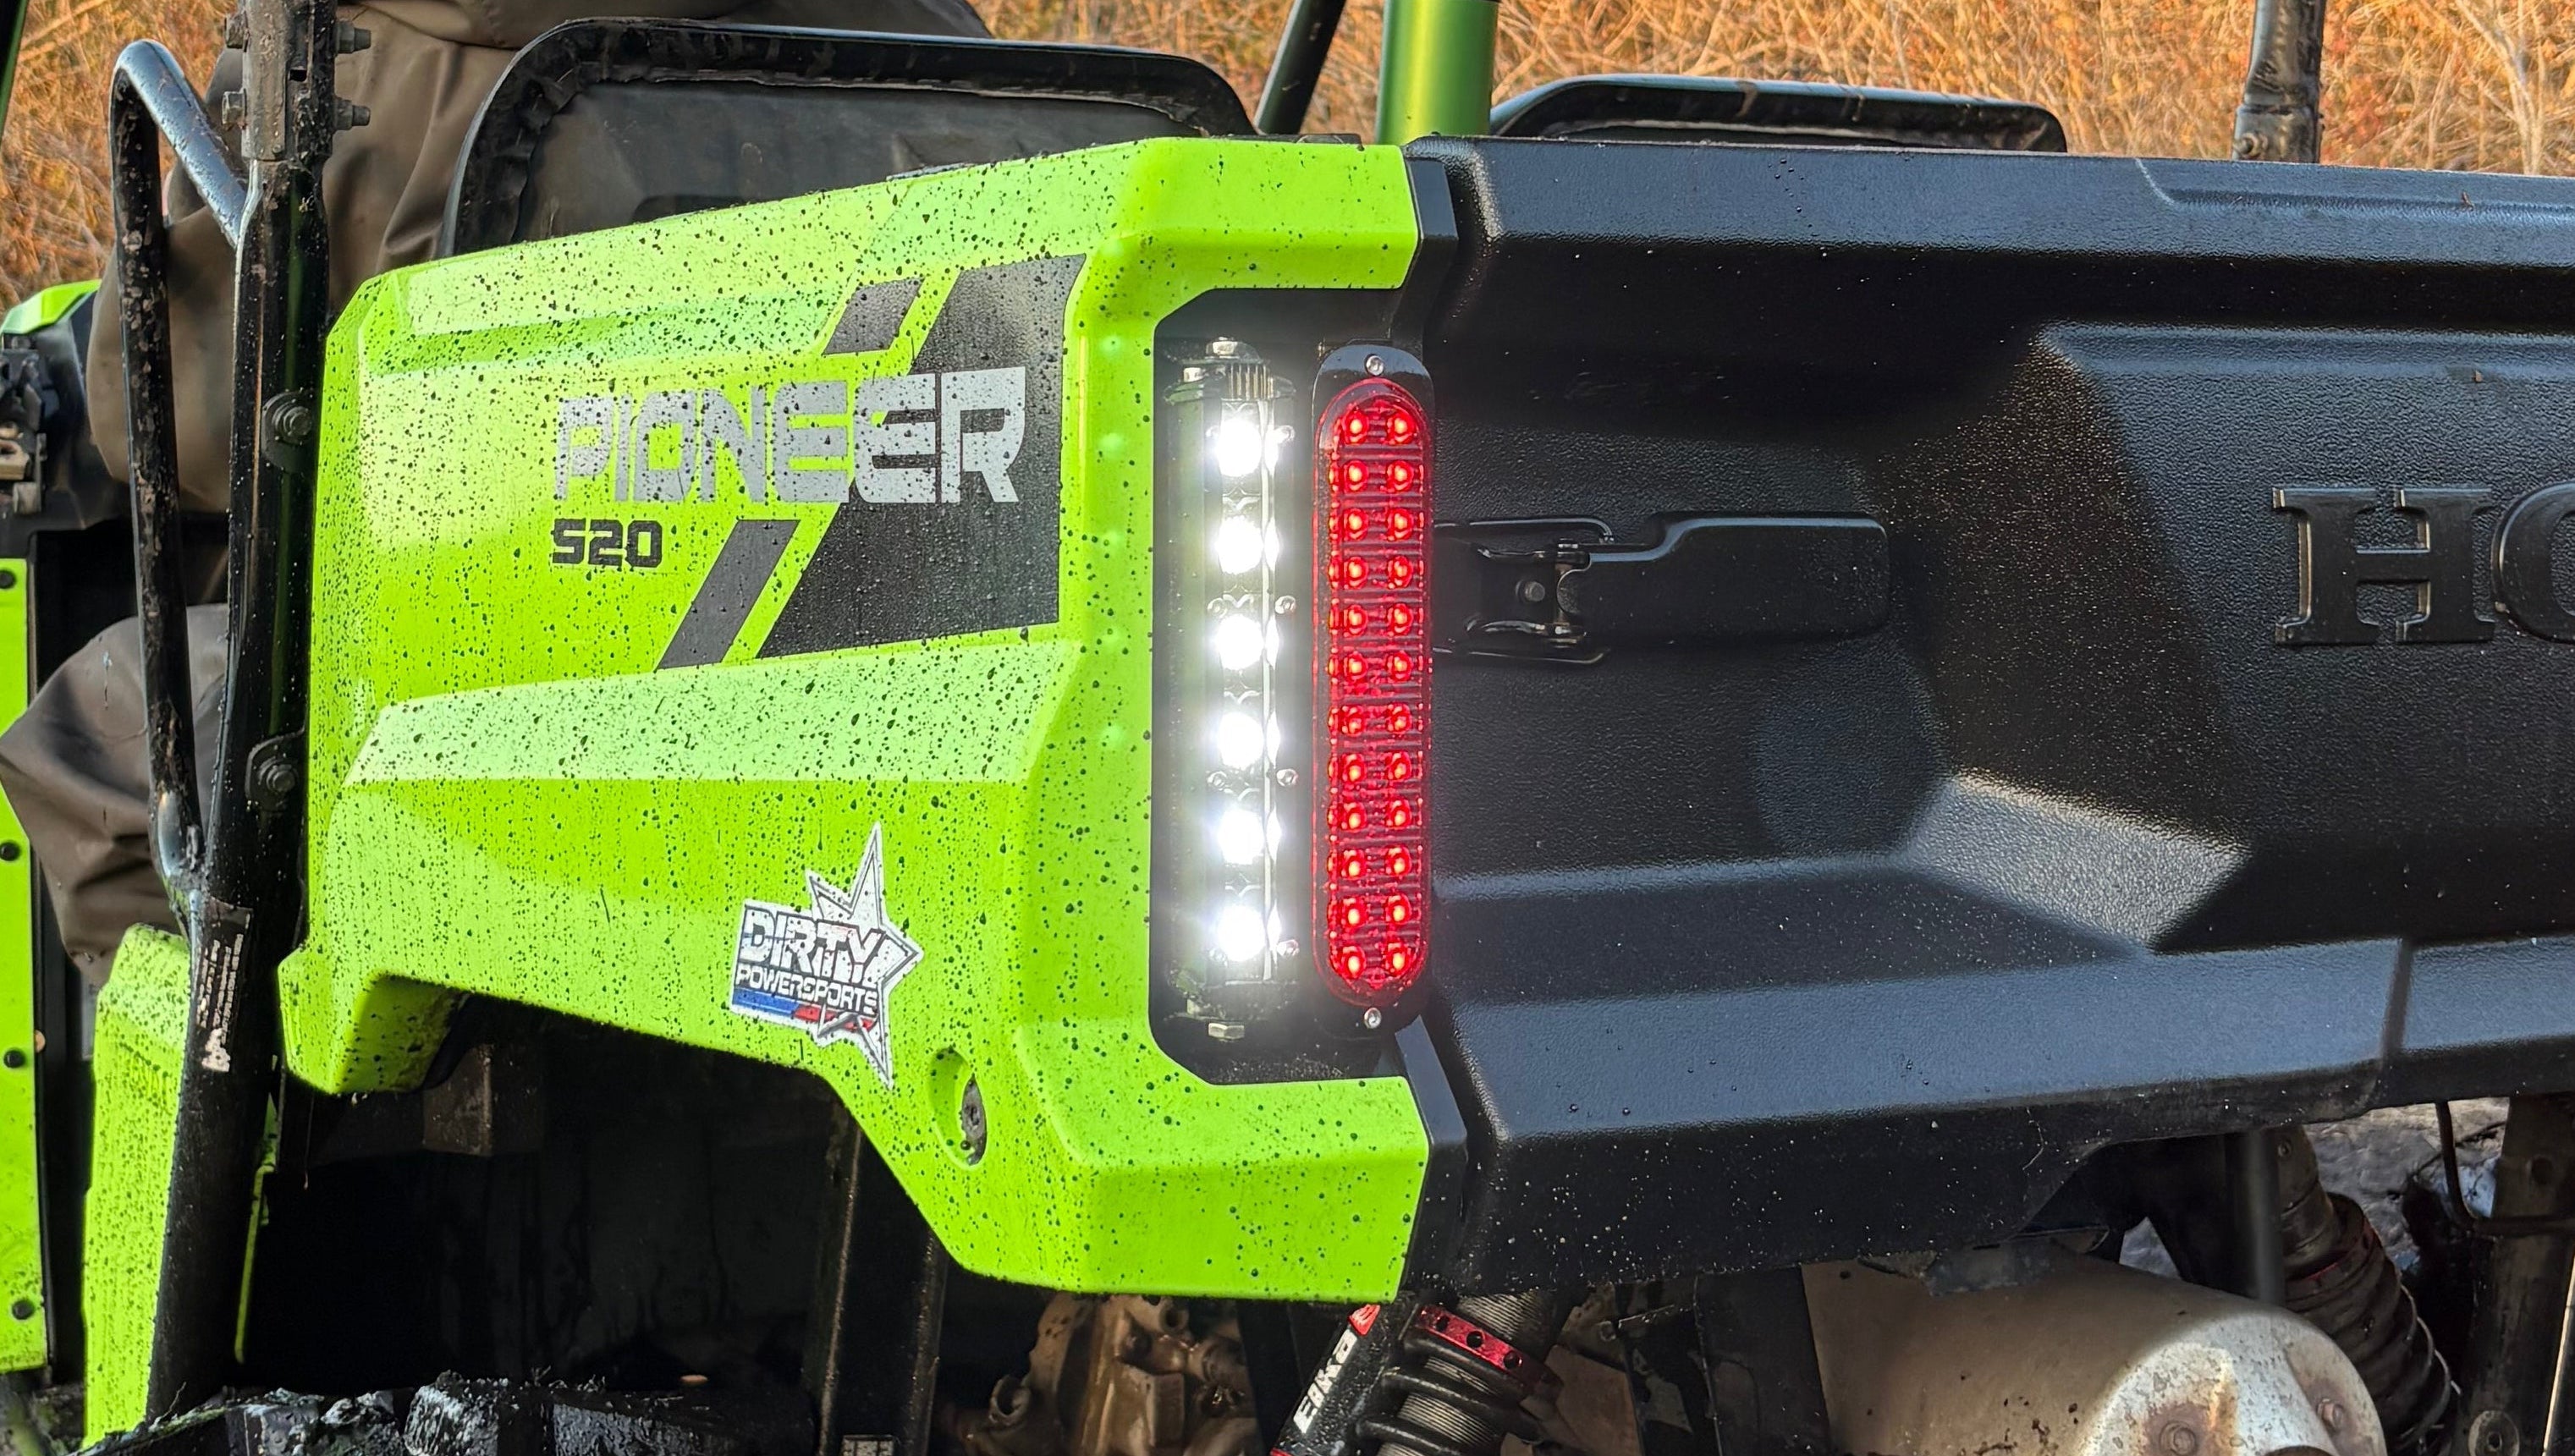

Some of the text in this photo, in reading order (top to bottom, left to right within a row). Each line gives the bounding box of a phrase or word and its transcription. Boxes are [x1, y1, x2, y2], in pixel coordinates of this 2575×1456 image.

[554, 366, 1025, 503] PIONEER
[552, 519, 663, 568] 520
[739, 904, 885, 986] DIRTY
[735, 964, 878, 1014] POWERSPORTS
[1293, 1329, 1358, 1434] Elka
